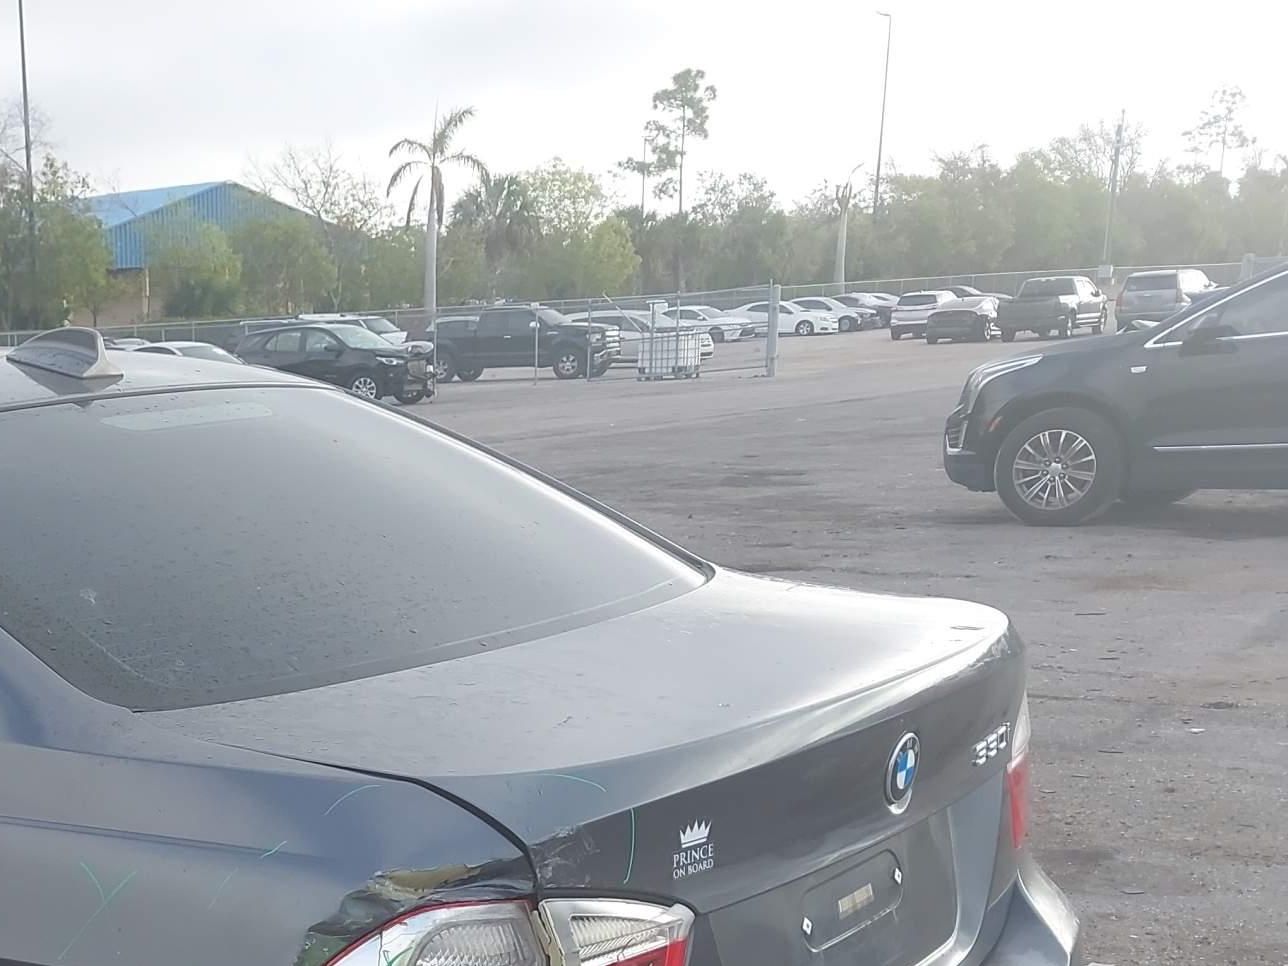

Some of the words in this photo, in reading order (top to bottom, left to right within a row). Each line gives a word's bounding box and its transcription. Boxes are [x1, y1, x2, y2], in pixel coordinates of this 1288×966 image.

[673, 843, 714, 868] PRINCE
[672, 866, 686, 879] ON
[688, 858, 714, 875] BOARD
